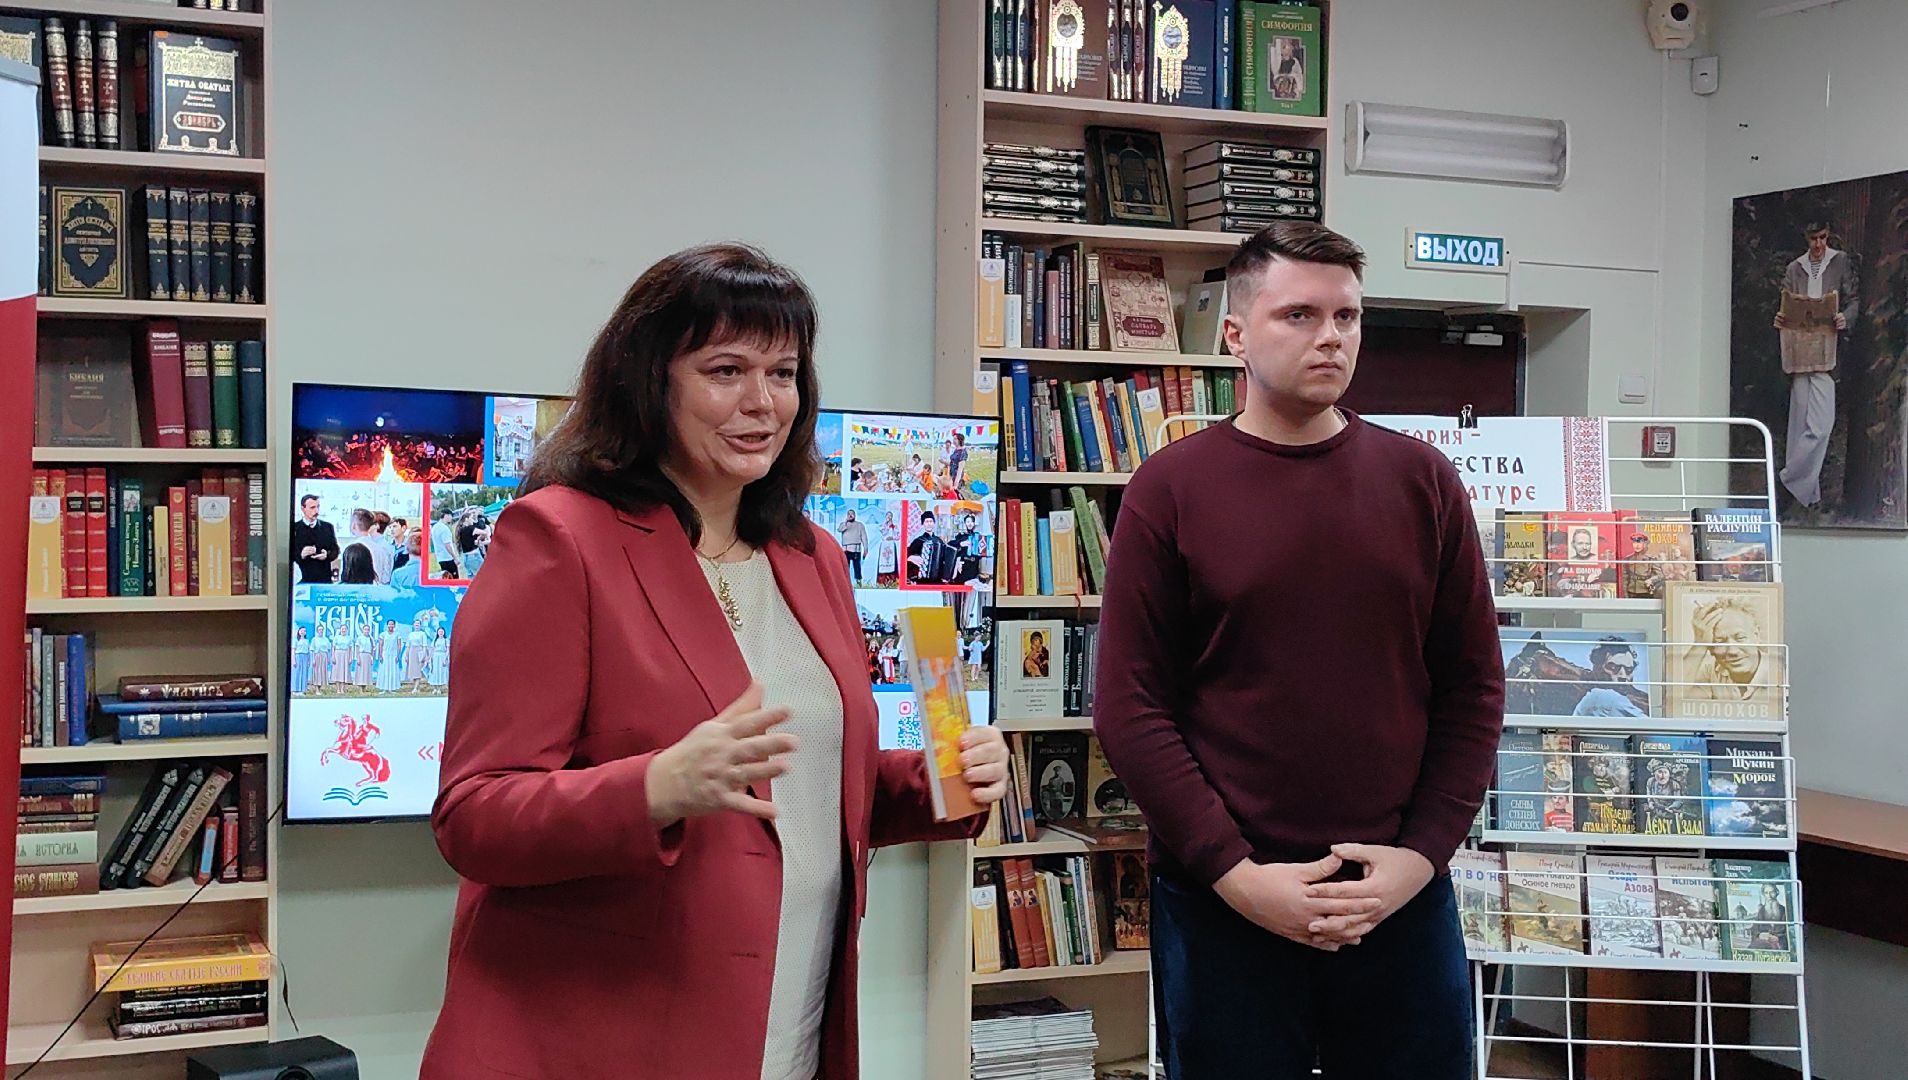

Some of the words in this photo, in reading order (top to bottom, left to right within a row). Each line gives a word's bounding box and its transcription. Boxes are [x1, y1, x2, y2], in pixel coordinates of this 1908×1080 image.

[1261, 20, 1313, 32] СИМФОНИЯ
[1417, 236, 1499, 266] ВЫХОД
[250, 507, 263, 536] ЗАКОН
[1682, 702, 1769, 718] ШОЛОХОВ
[1732, 759, 1775, 769] Щукин
[1733, 773, 1776, 785] Морок
[1510, 800, 1534, 809] СЫНЫ
[1509, 809, 1536, 819] СТЕПЕЙ
[1505, 820, 1540, 831] ДОНСКИХ
[1551, 882, 1576, 890] гнездо
[1624, 883, 1654, 893] Азова
